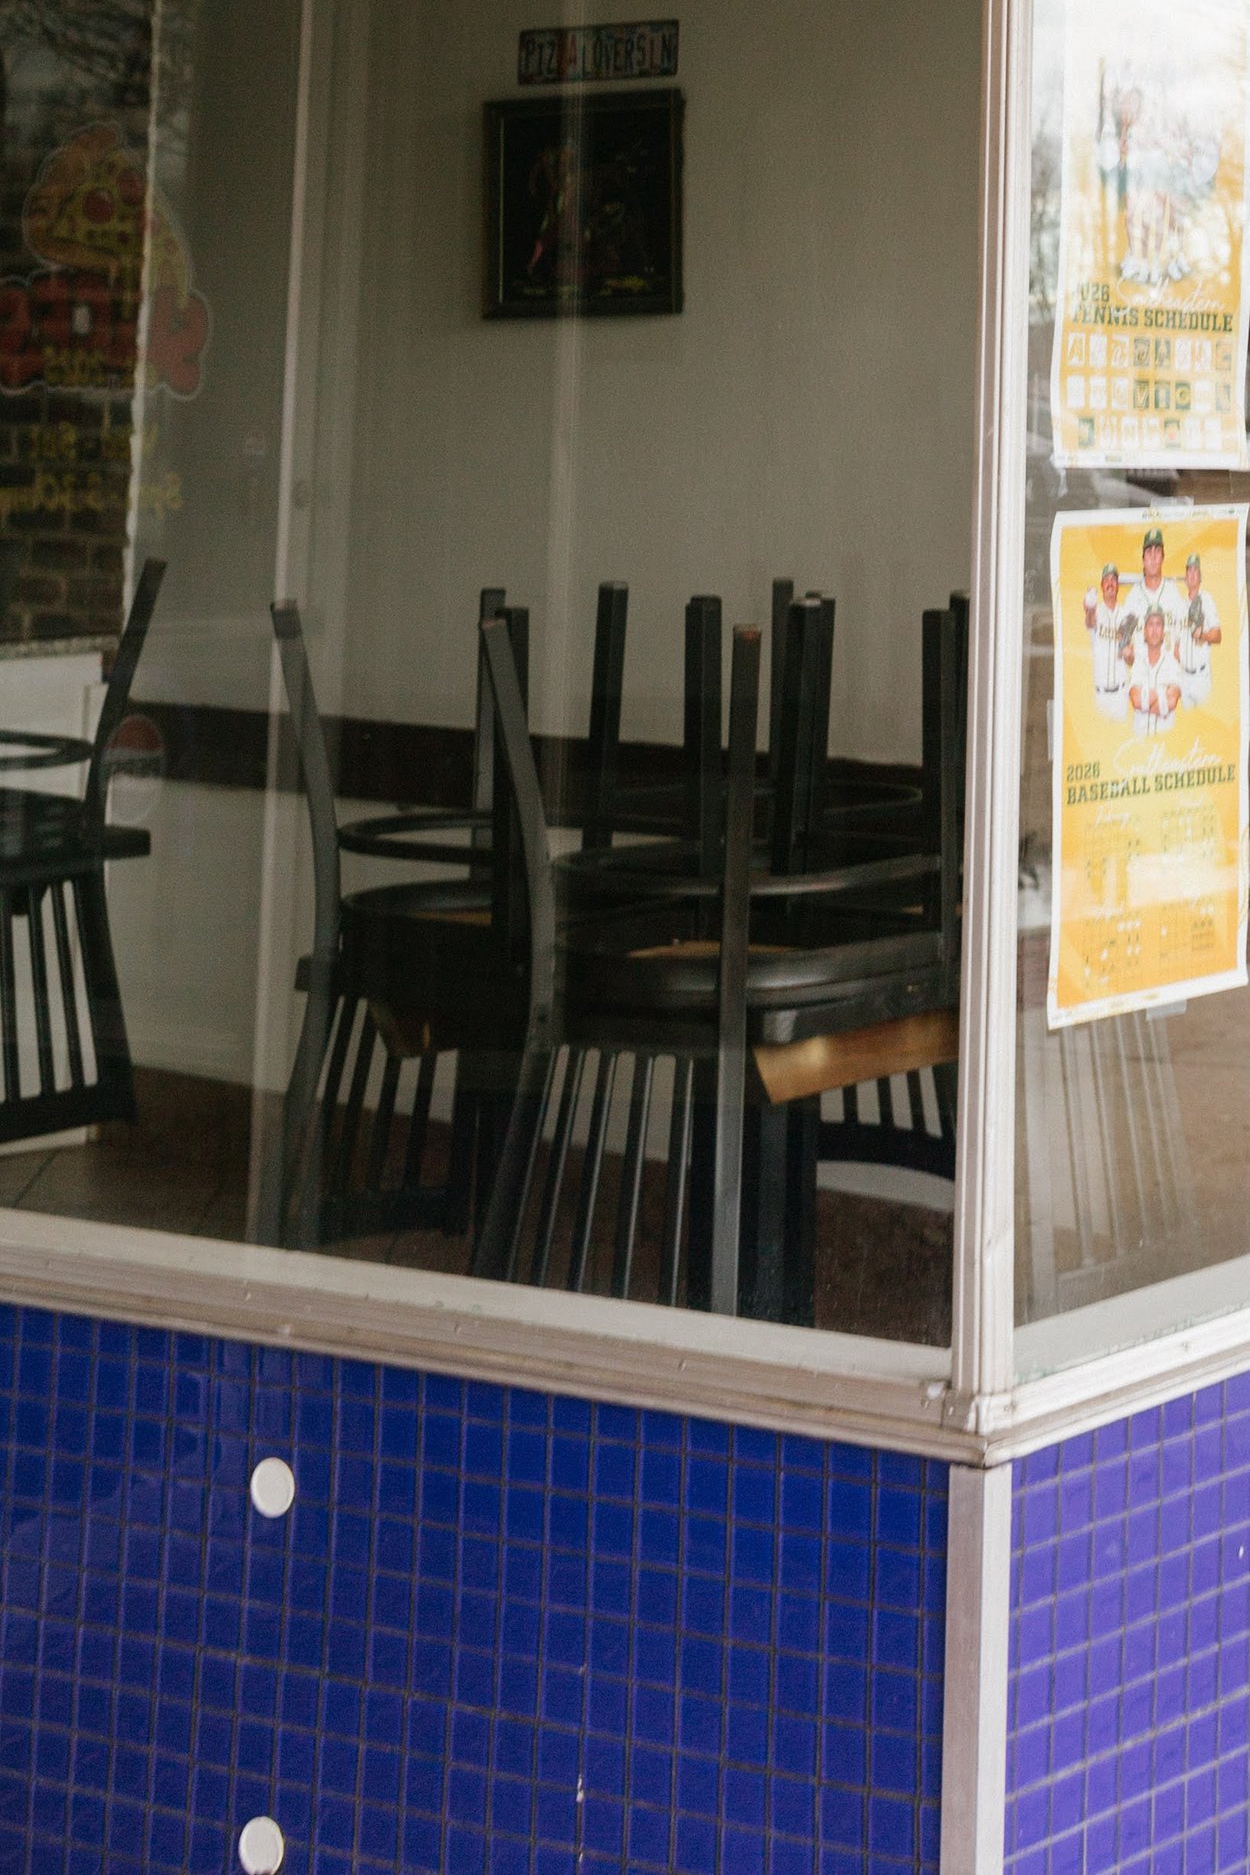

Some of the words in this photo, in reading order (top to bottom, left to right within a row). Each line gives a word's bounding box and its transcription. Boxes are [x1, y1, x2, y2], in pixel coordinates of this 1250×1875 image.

[523, 33, 578, 77] PIZA
[1144, 307, 1233, 332] SCHEDULE
[1066, 760, 1101, 783] 2026
[1066, 774, 1151, 806] BASEBALL
[1153, 762, 1236, 792] SCHEDULE
